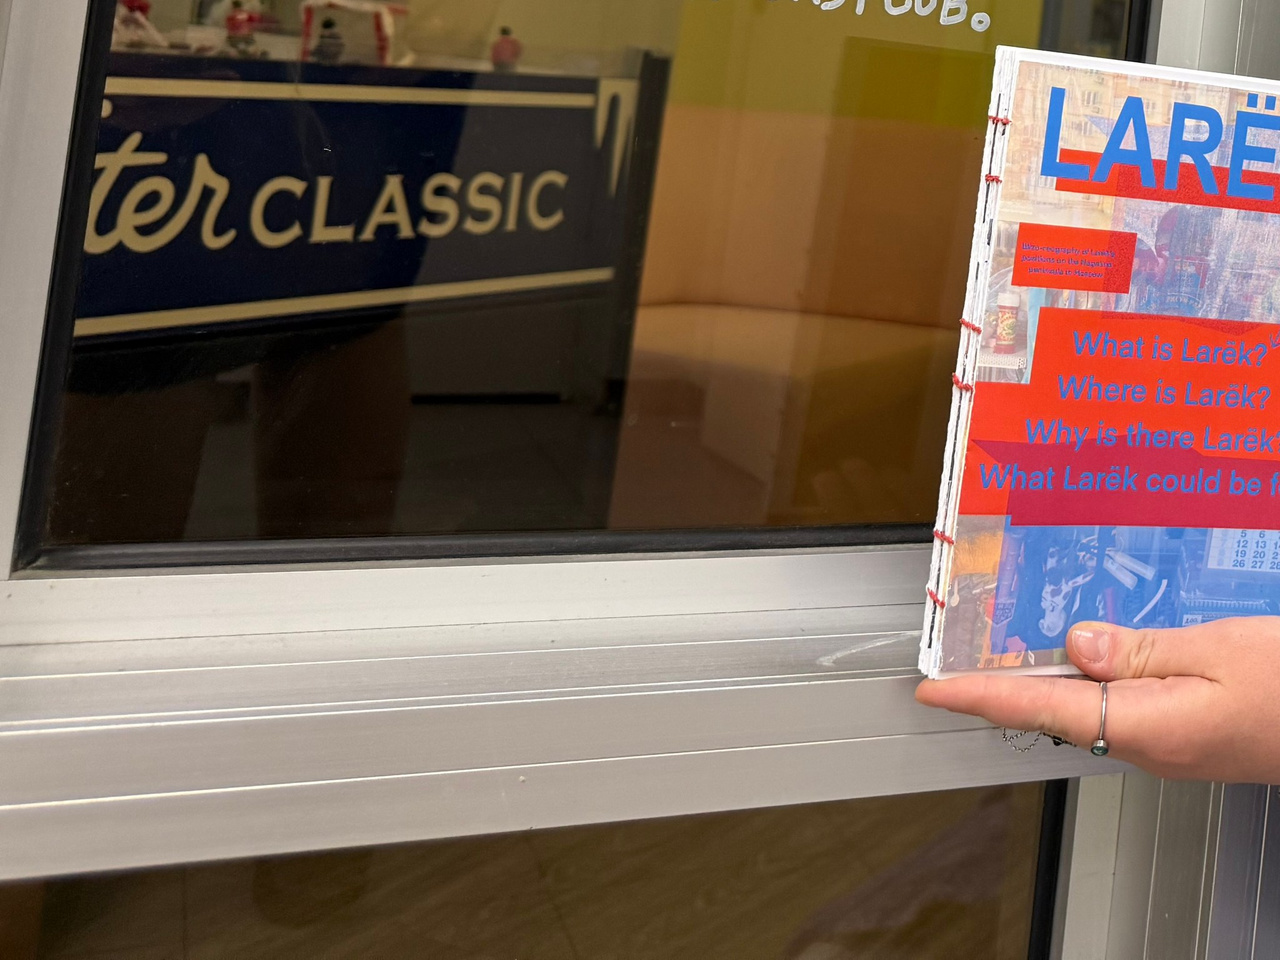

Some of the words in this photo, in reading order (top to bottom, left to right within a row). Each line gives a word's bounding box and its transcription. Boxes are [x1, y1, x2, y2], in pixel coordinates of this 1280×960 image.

[83, 131, 236, 254] ter
[250, 171, 568, 247] CLASSIC
[1073, 331, 1144, 359] What
[1152, 338, 1172, 361] is
[1182, 339, 1268, 366] Larëk?
[1058, 375, 1147, 402] Where
[1155, 380, 1176, 405] is
[1185, 382, 1271, 409] Larëk?
[1026, 419, 1089, 451] Why
[1096, 422, 1117, 446] is
[1127, 422, 1194, 449] there
[980, 463, 1055, 490] What
[1063, 464, 1138, 491] Larëk
[1146, 468, 1222, 494] could
[1229, 470, 1262, 496] be
